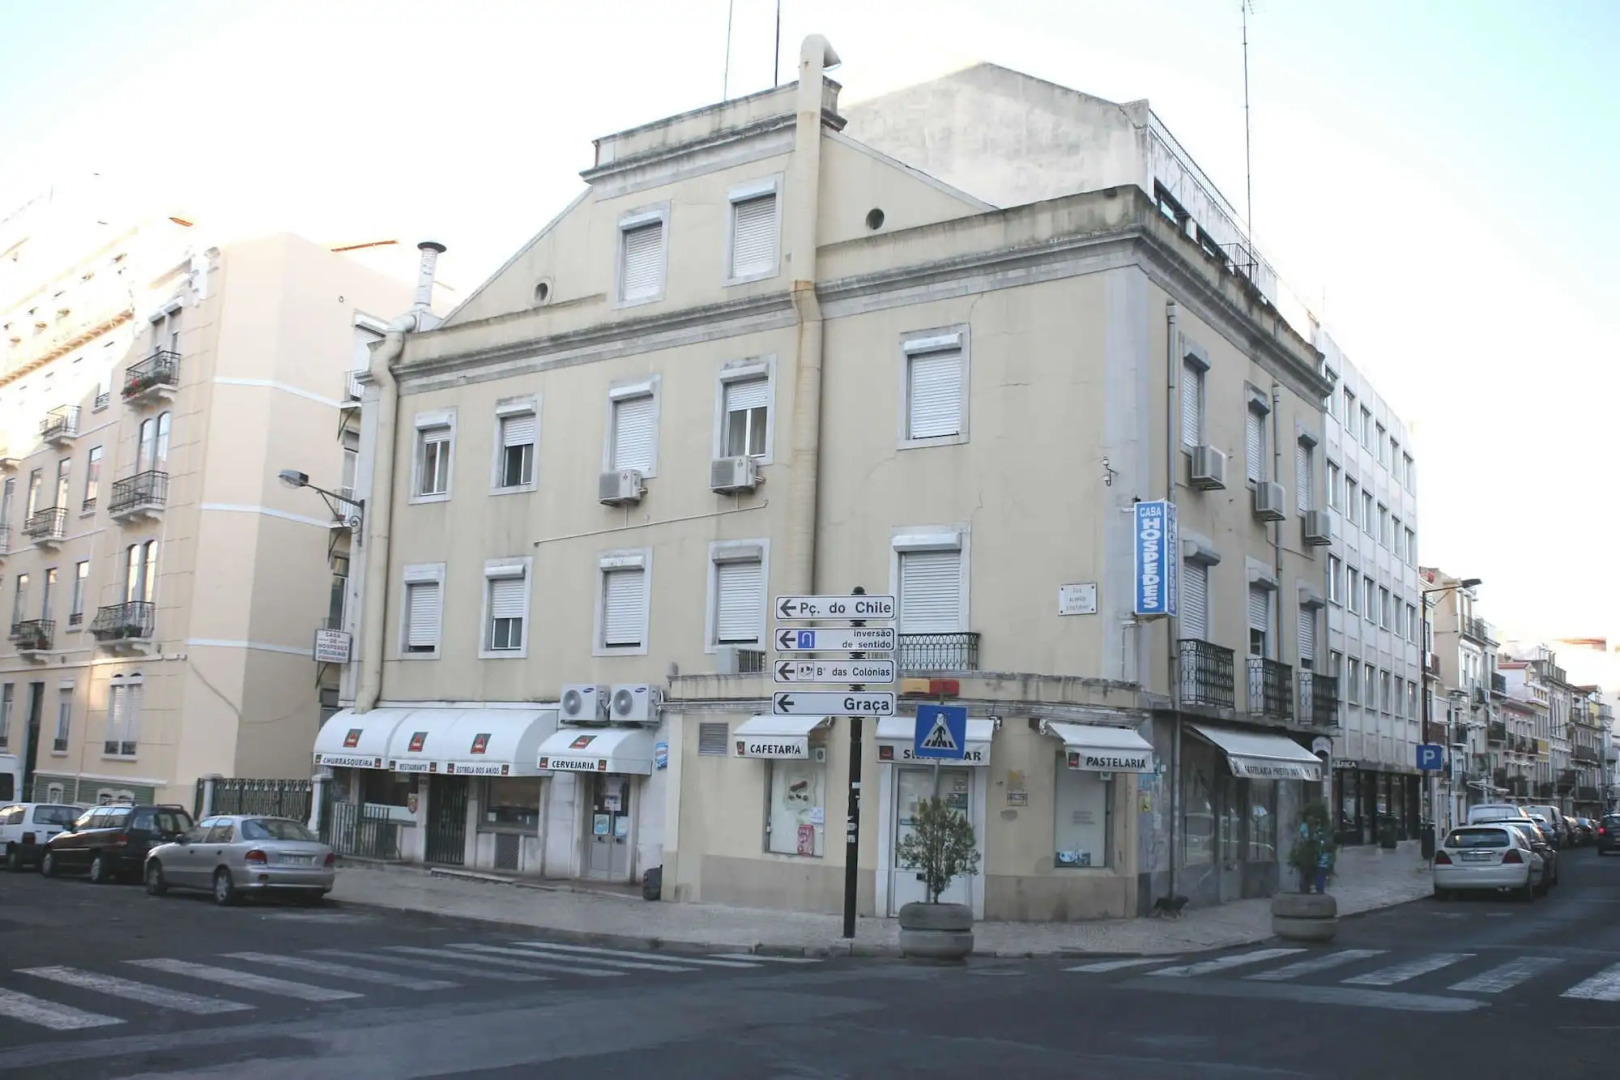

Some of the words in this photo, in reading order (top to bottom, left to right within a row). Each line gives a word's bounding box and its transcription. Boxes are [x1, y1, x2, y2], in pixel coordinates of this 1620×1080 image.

[1140, 507, 1161, 517] CASA
[1140, 518, 1161, 609] HOSPEDES
[800, 602, 820, 616] Pç.
[829, 602, 846, 614] do
[855, 601, 891, 614] Chile
[832, 667, 847, 676] das
[852, 667, 891, 676] Colónias
[844, 697, 889, 714] Graça
[750, 744, 801, 754] CAFETARIA
[322, 757, 373, 766] CHURRASQUEIRA
[1086, 757, 1146, 769] PASTELARIA
[1423, 750, 1435, 765] P
[552, 760, 595, 769] CERVEJARIA
